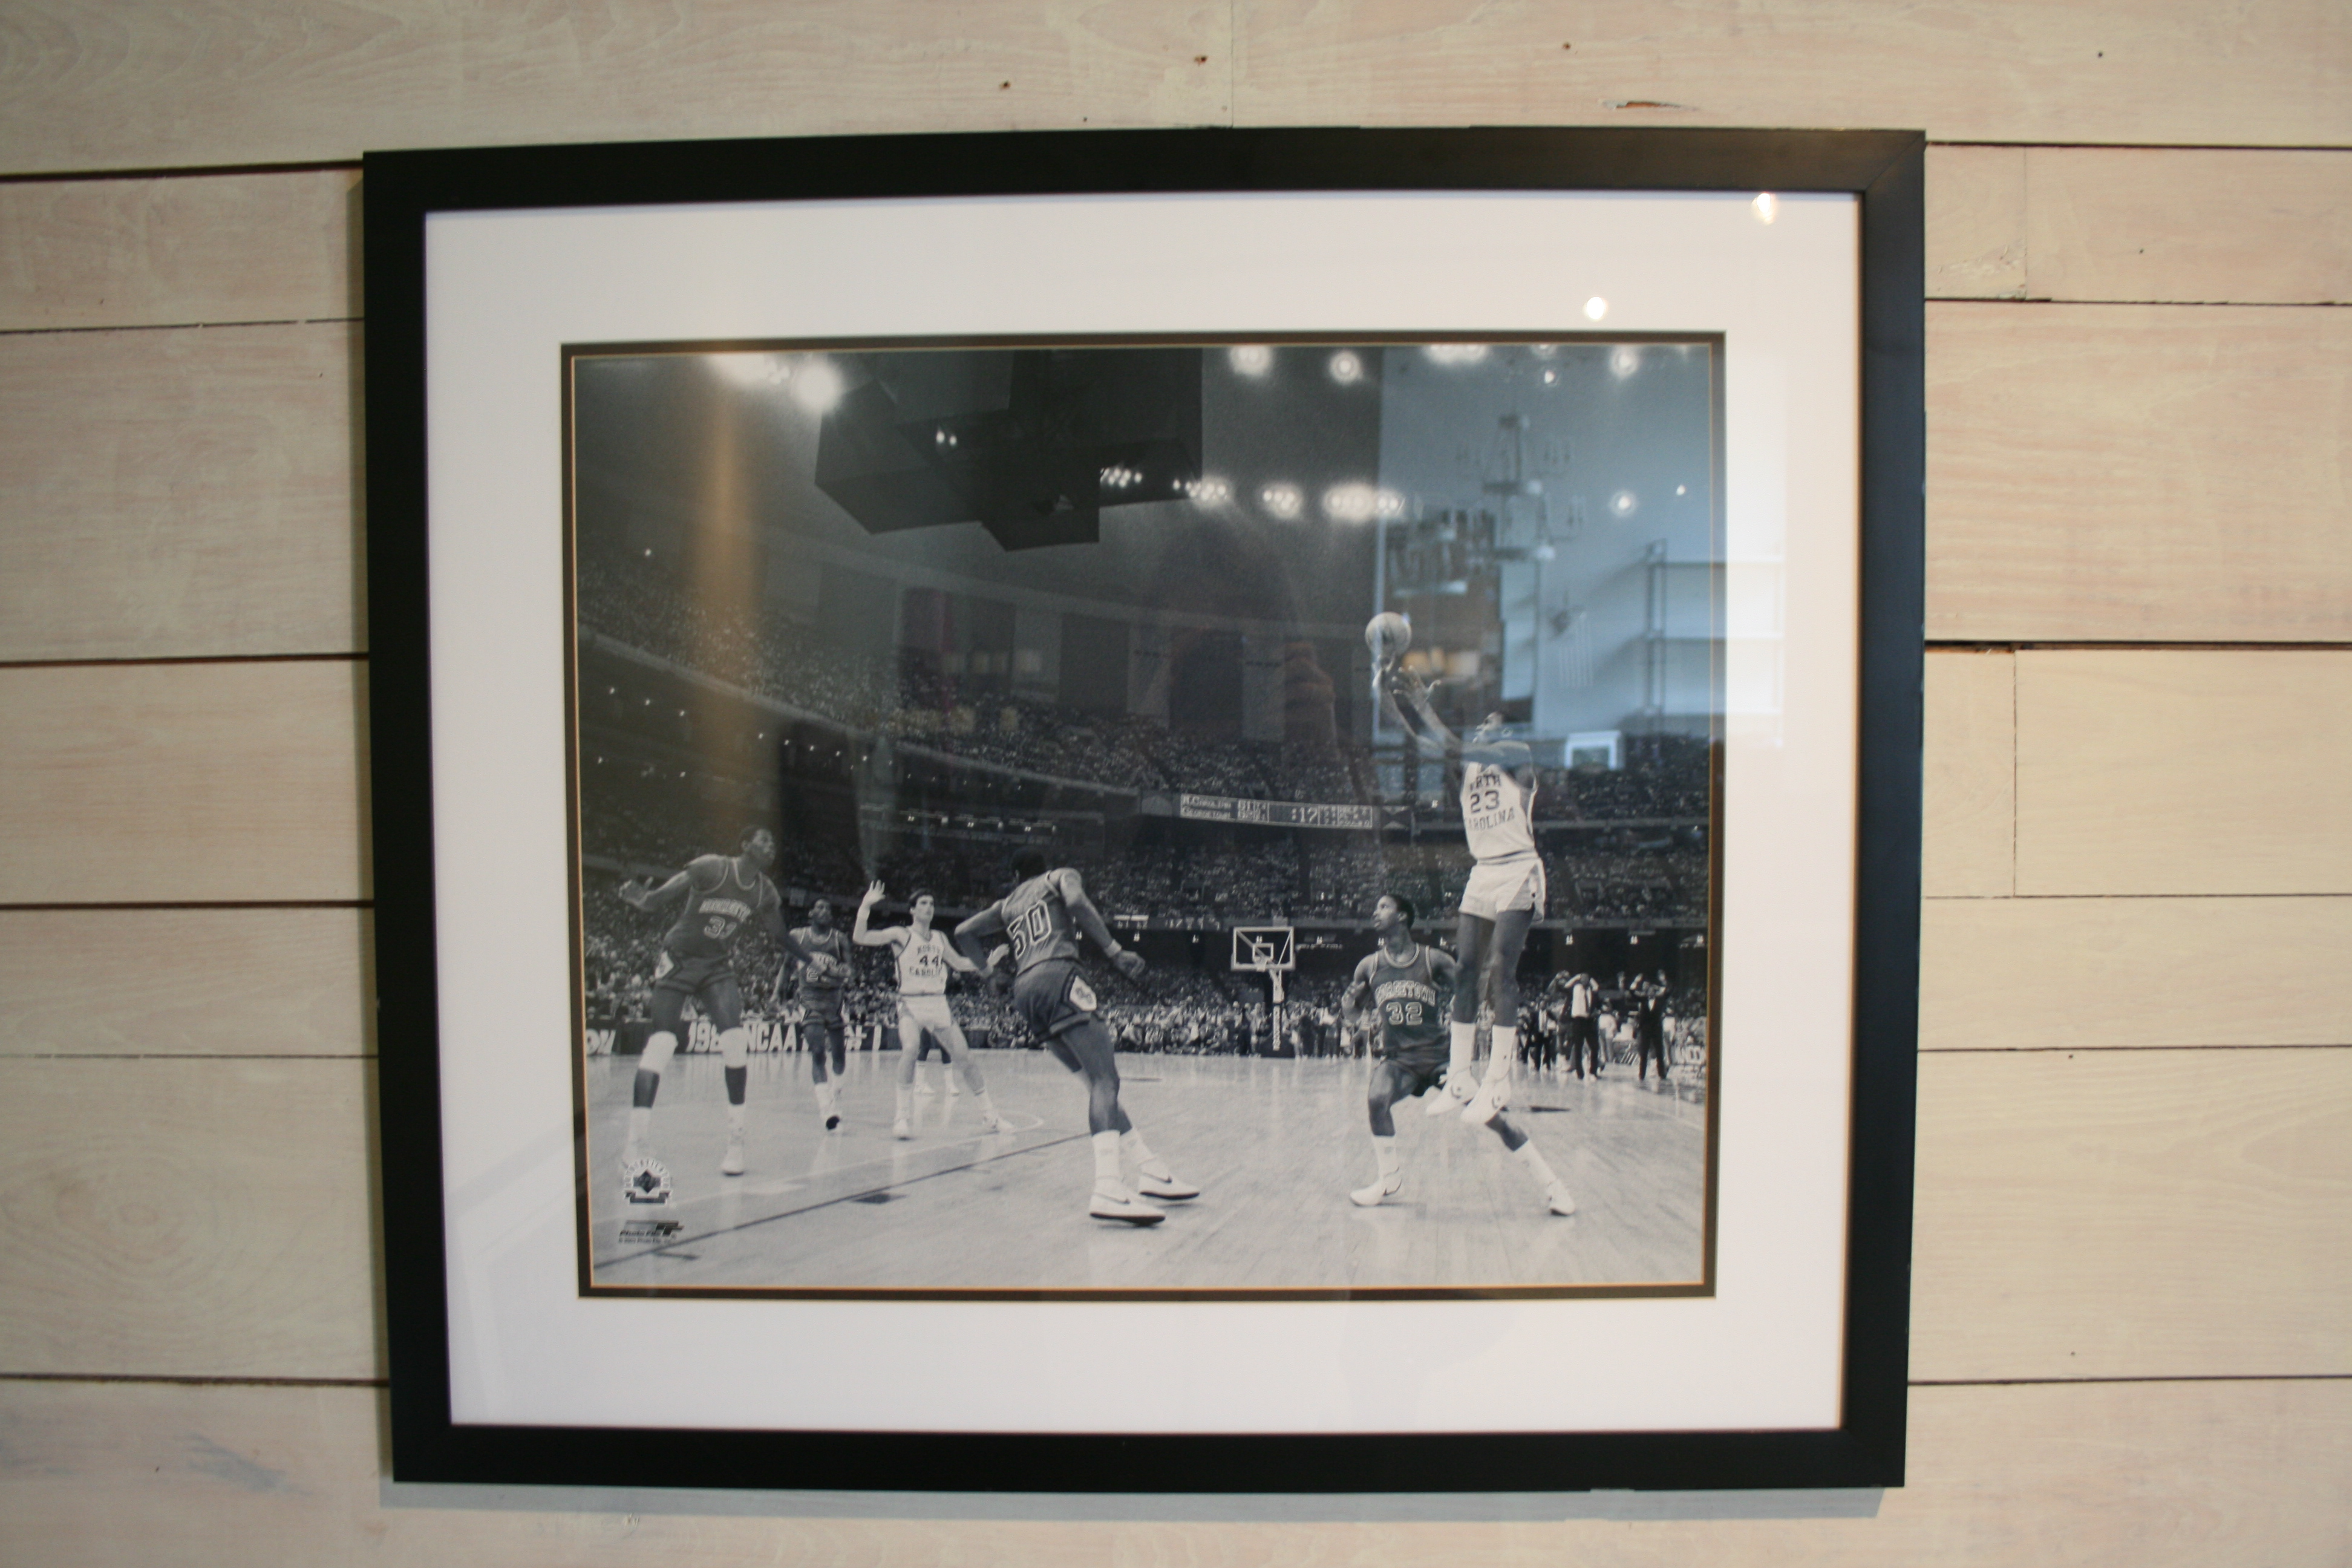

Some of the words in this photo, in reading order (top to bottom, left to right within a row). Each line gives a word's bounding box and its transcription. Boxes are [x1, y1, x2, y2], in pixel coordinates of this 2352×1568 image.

[1470, 790, 1500, 813] 23
[1007, 900, 1052, 960] 50
[920, 955, 940, 967] 44
[1386, 1002, 1423, 1025] 32
[743, 1021, 797, 1051] NCAA
